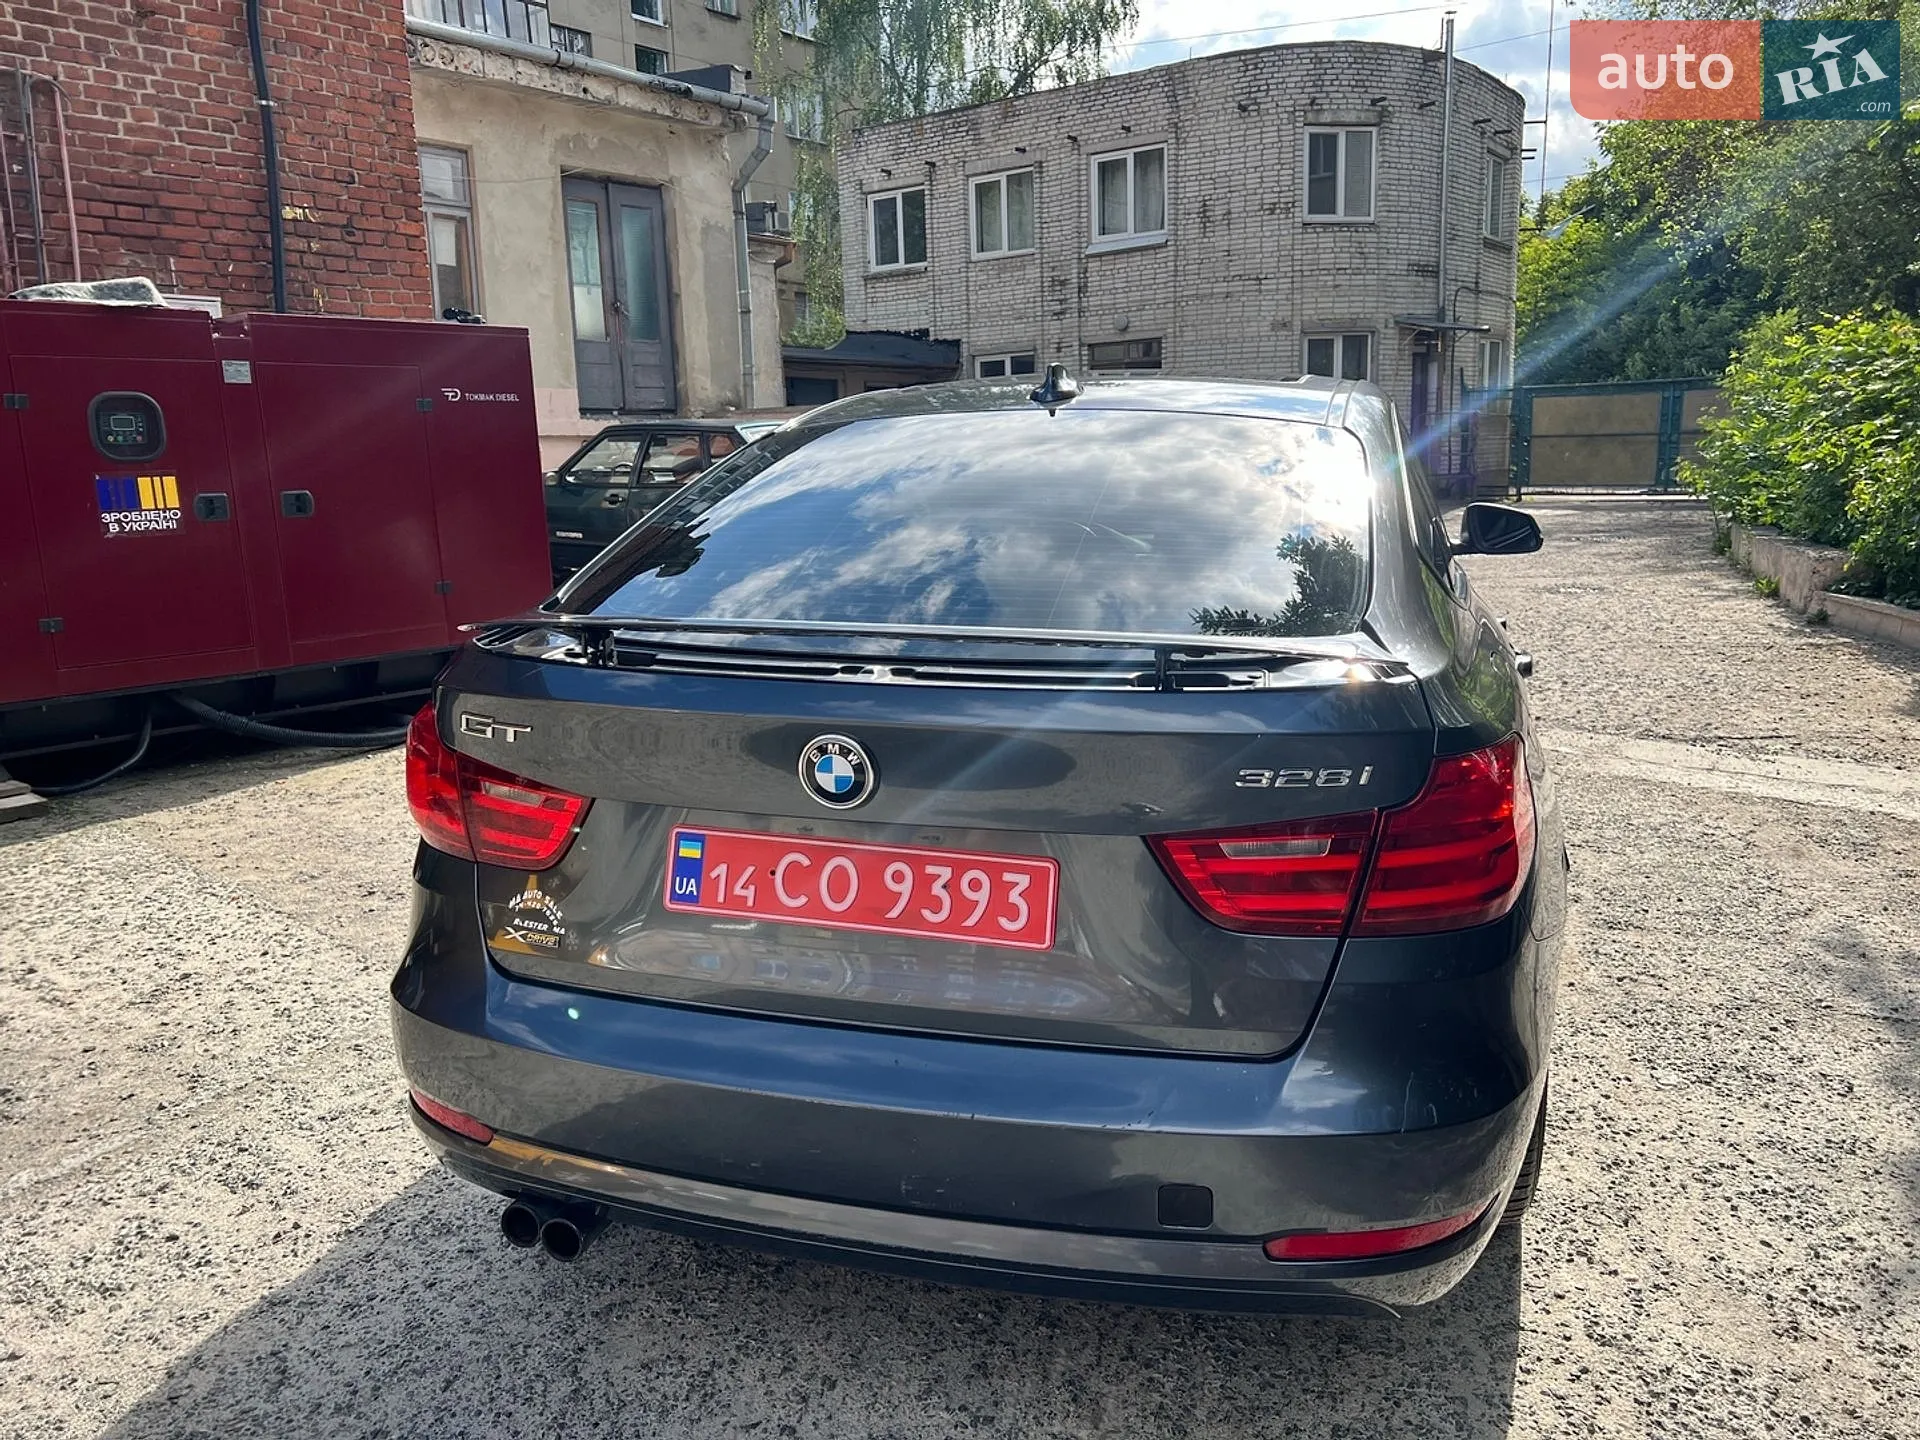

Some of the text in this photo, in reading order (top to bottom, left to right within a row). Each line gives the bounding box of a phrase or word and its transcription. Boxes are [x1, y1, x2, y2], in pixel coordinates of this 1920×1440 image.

[464, 393, 520, 402] TOKMAK DIESEL
[101, 509, 181, 523] ЗРОБЛЕНО
[108, 519, 177, 532] В УКРАЇНІ
[460, 711, 533, 743] GT
[809, 743, 860, 766] BMW
[1235, 766, 1374, 788] 328i
[522, 889, 543, 900] AUTO
[675, 876, 698, 896] UA
[709, 852, 1032, 932] 14 CO 9393
